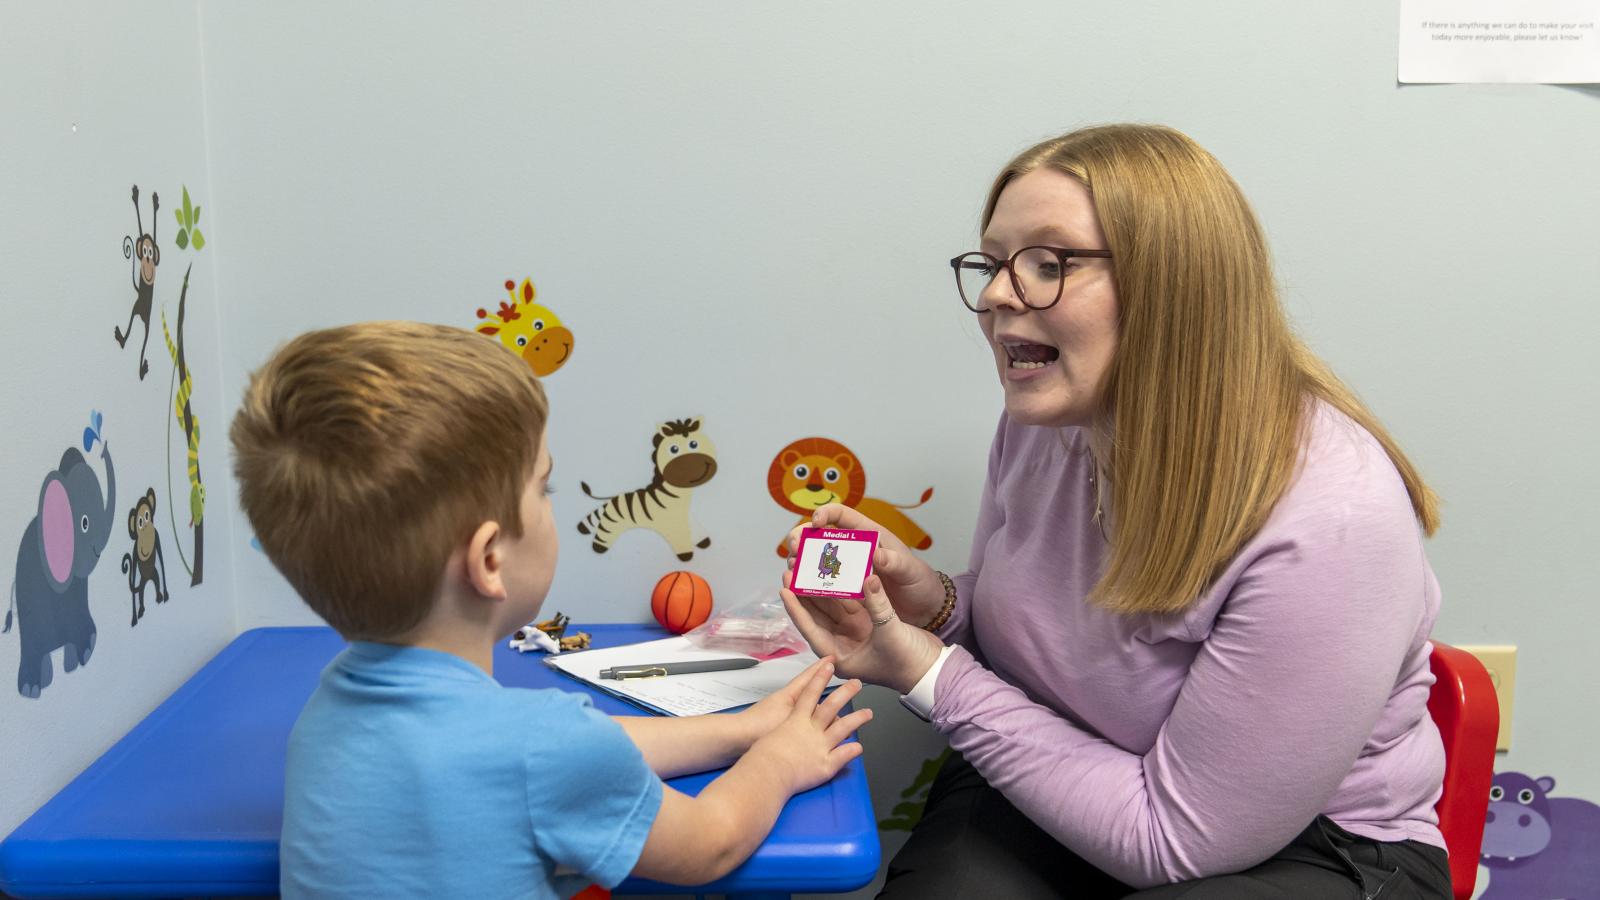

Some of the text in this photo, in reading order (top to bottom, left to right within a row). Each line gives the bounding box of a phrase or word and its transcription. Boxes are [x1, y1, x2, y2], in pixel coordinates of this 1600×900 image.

[1457, 21, 1489, 30] anything
[1431, 33, 1452, 42] today
[1475, 33, 1512, 42] enjoyable,
[1513, 33, 1537, 42] please
[823, 531, 849, 539] Medial
